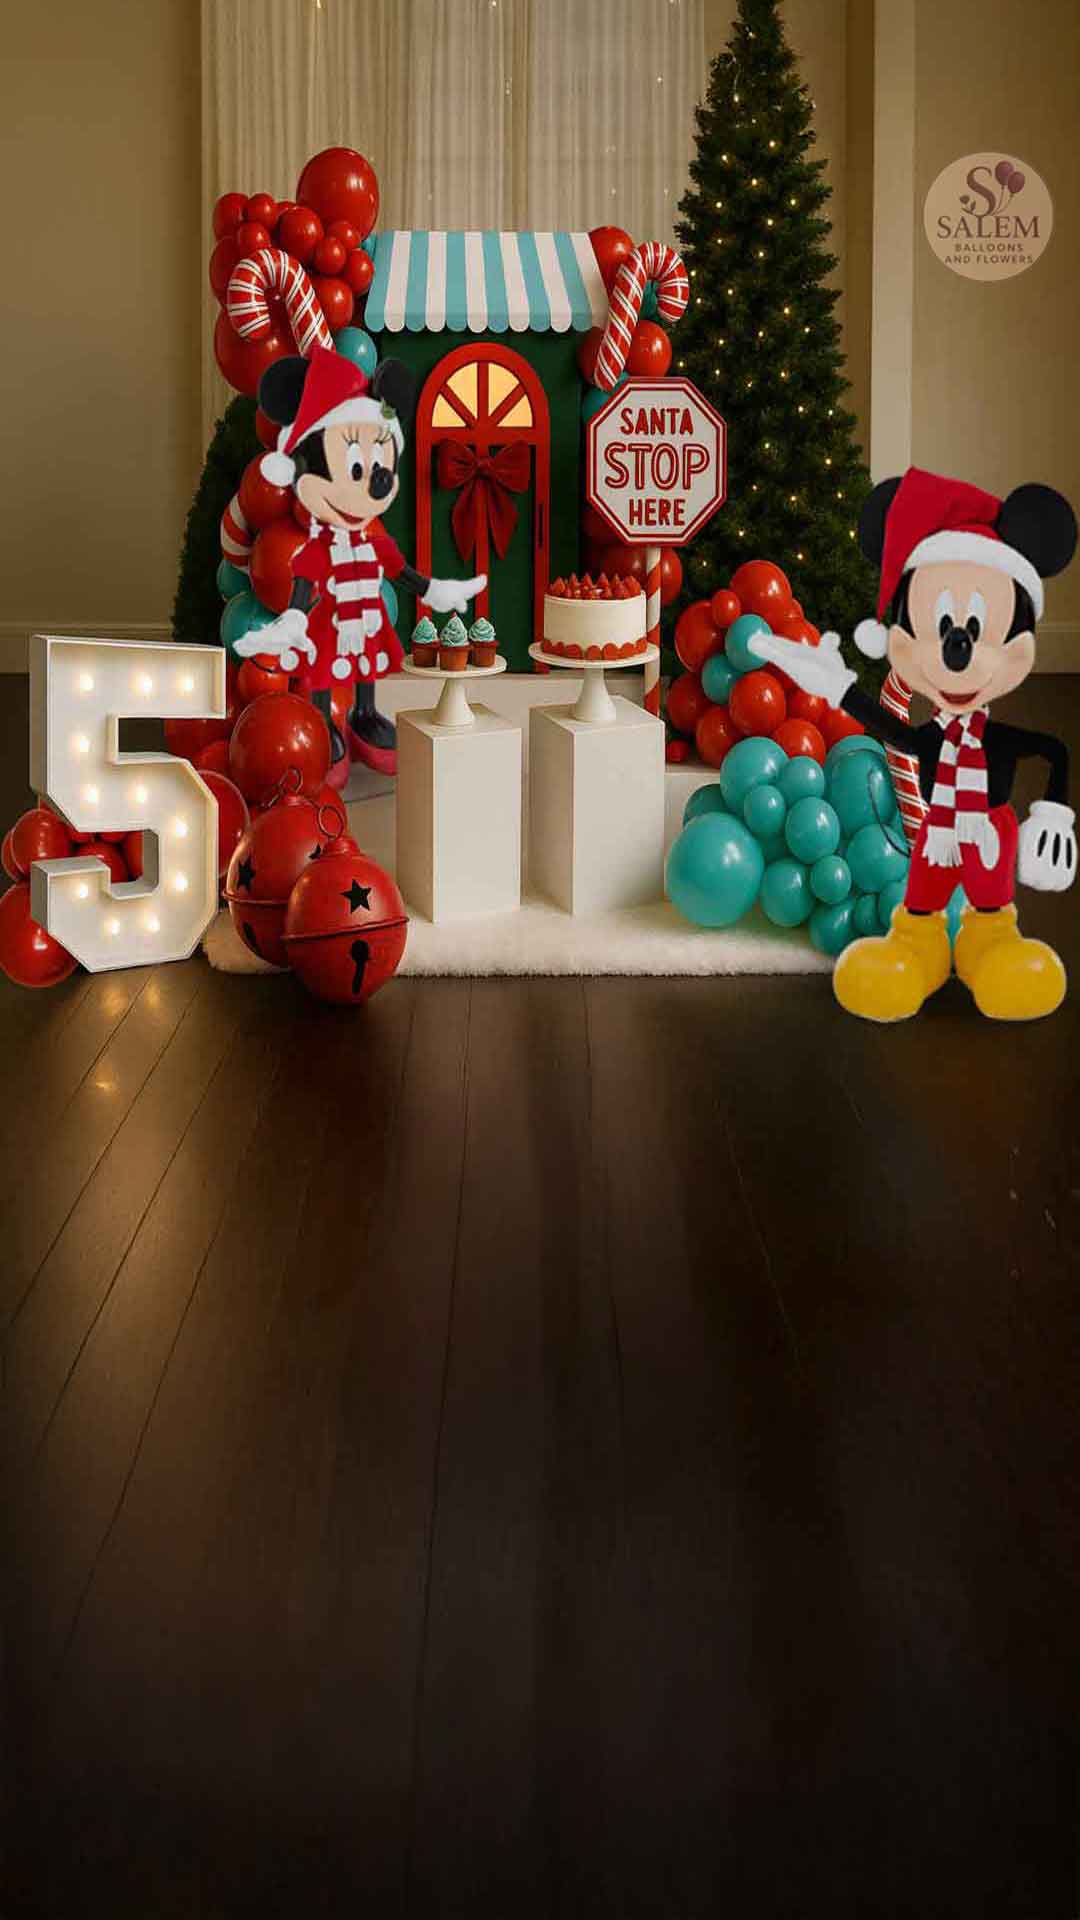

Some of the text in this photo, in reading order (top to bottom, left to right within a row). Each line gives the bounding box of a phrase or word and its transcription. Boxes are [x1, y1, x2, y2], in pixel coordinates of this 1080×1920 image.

[620, 407, 694, 436] SANTA
[604, 441, 710, 490] STOP
[628, 498, 686, 527] HERE
[29, 634, 227, 973] 5
